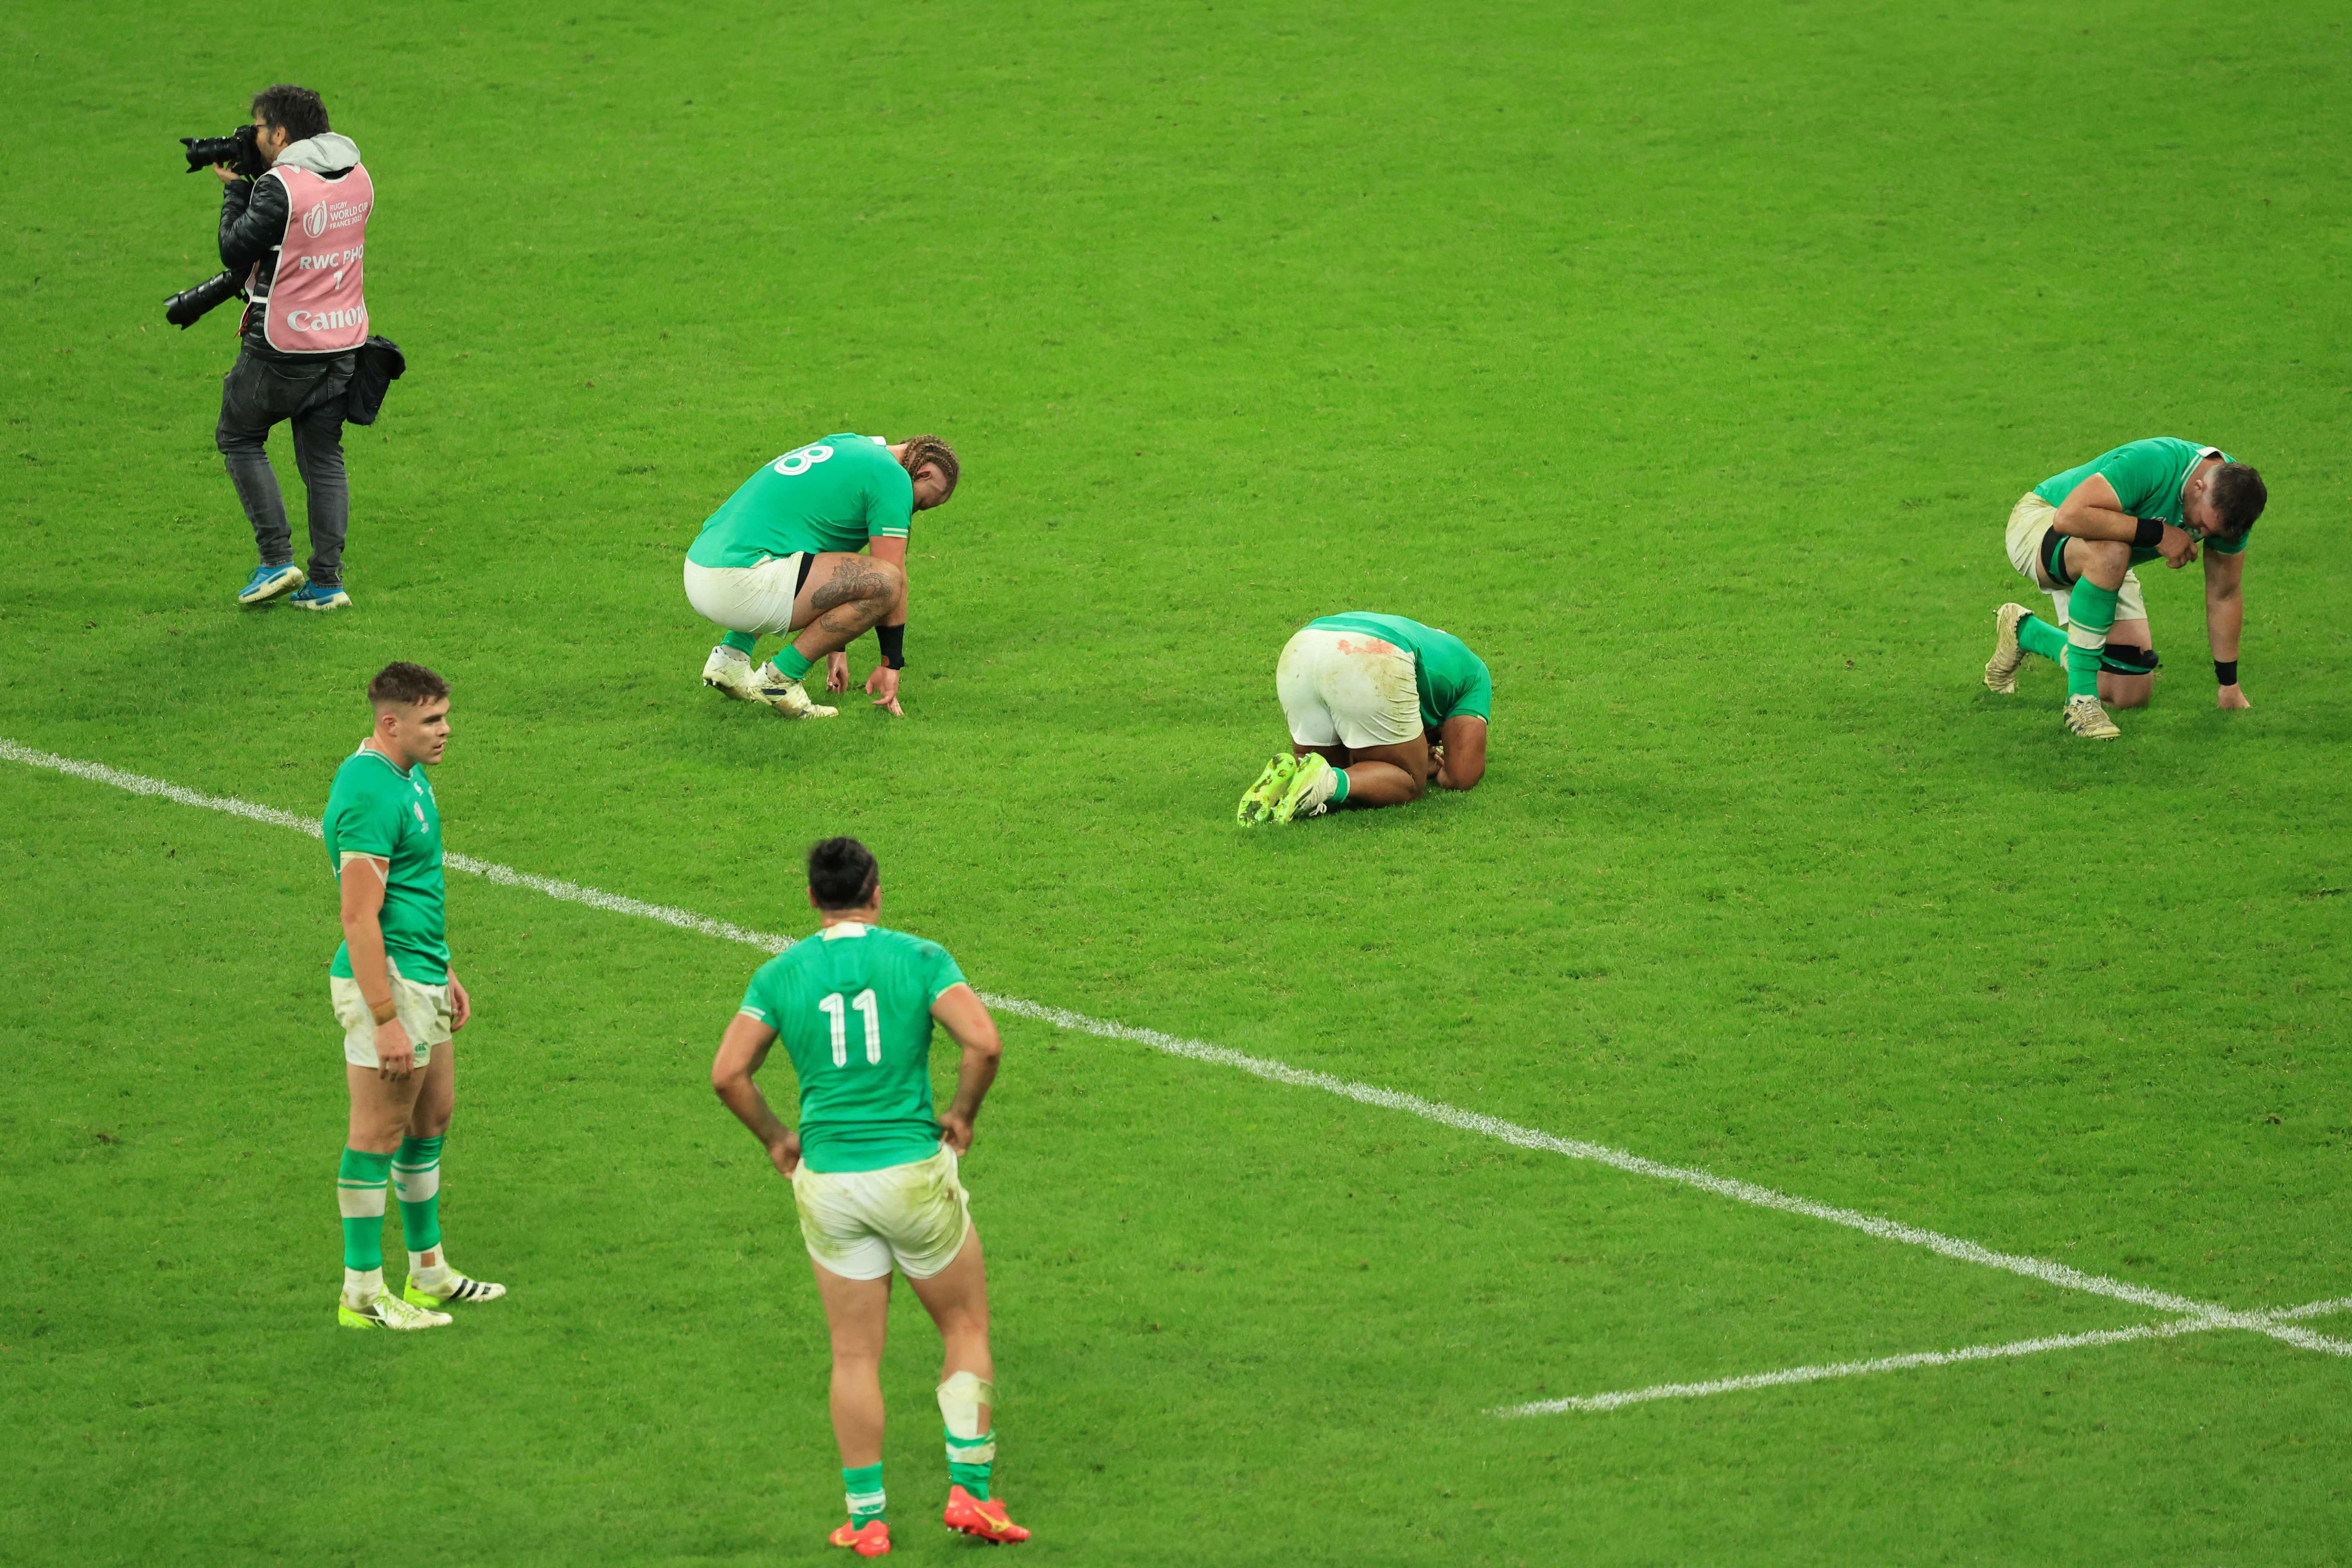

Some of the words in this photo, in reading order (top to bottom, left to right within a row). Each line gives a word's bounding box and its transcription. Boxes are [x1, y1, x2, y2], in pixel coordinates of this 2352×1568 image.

[330, 200, 347, 211] RUGBY
[330, 206, 357, 221] WORLD
[358, 202, 368, 212] CUP
[330, 219, 351, 229] FRANCE
[352, 214, 362, 224] 2023
[299, 253, 339, 270] RWC
[818, 988, 881, 1068] 11
